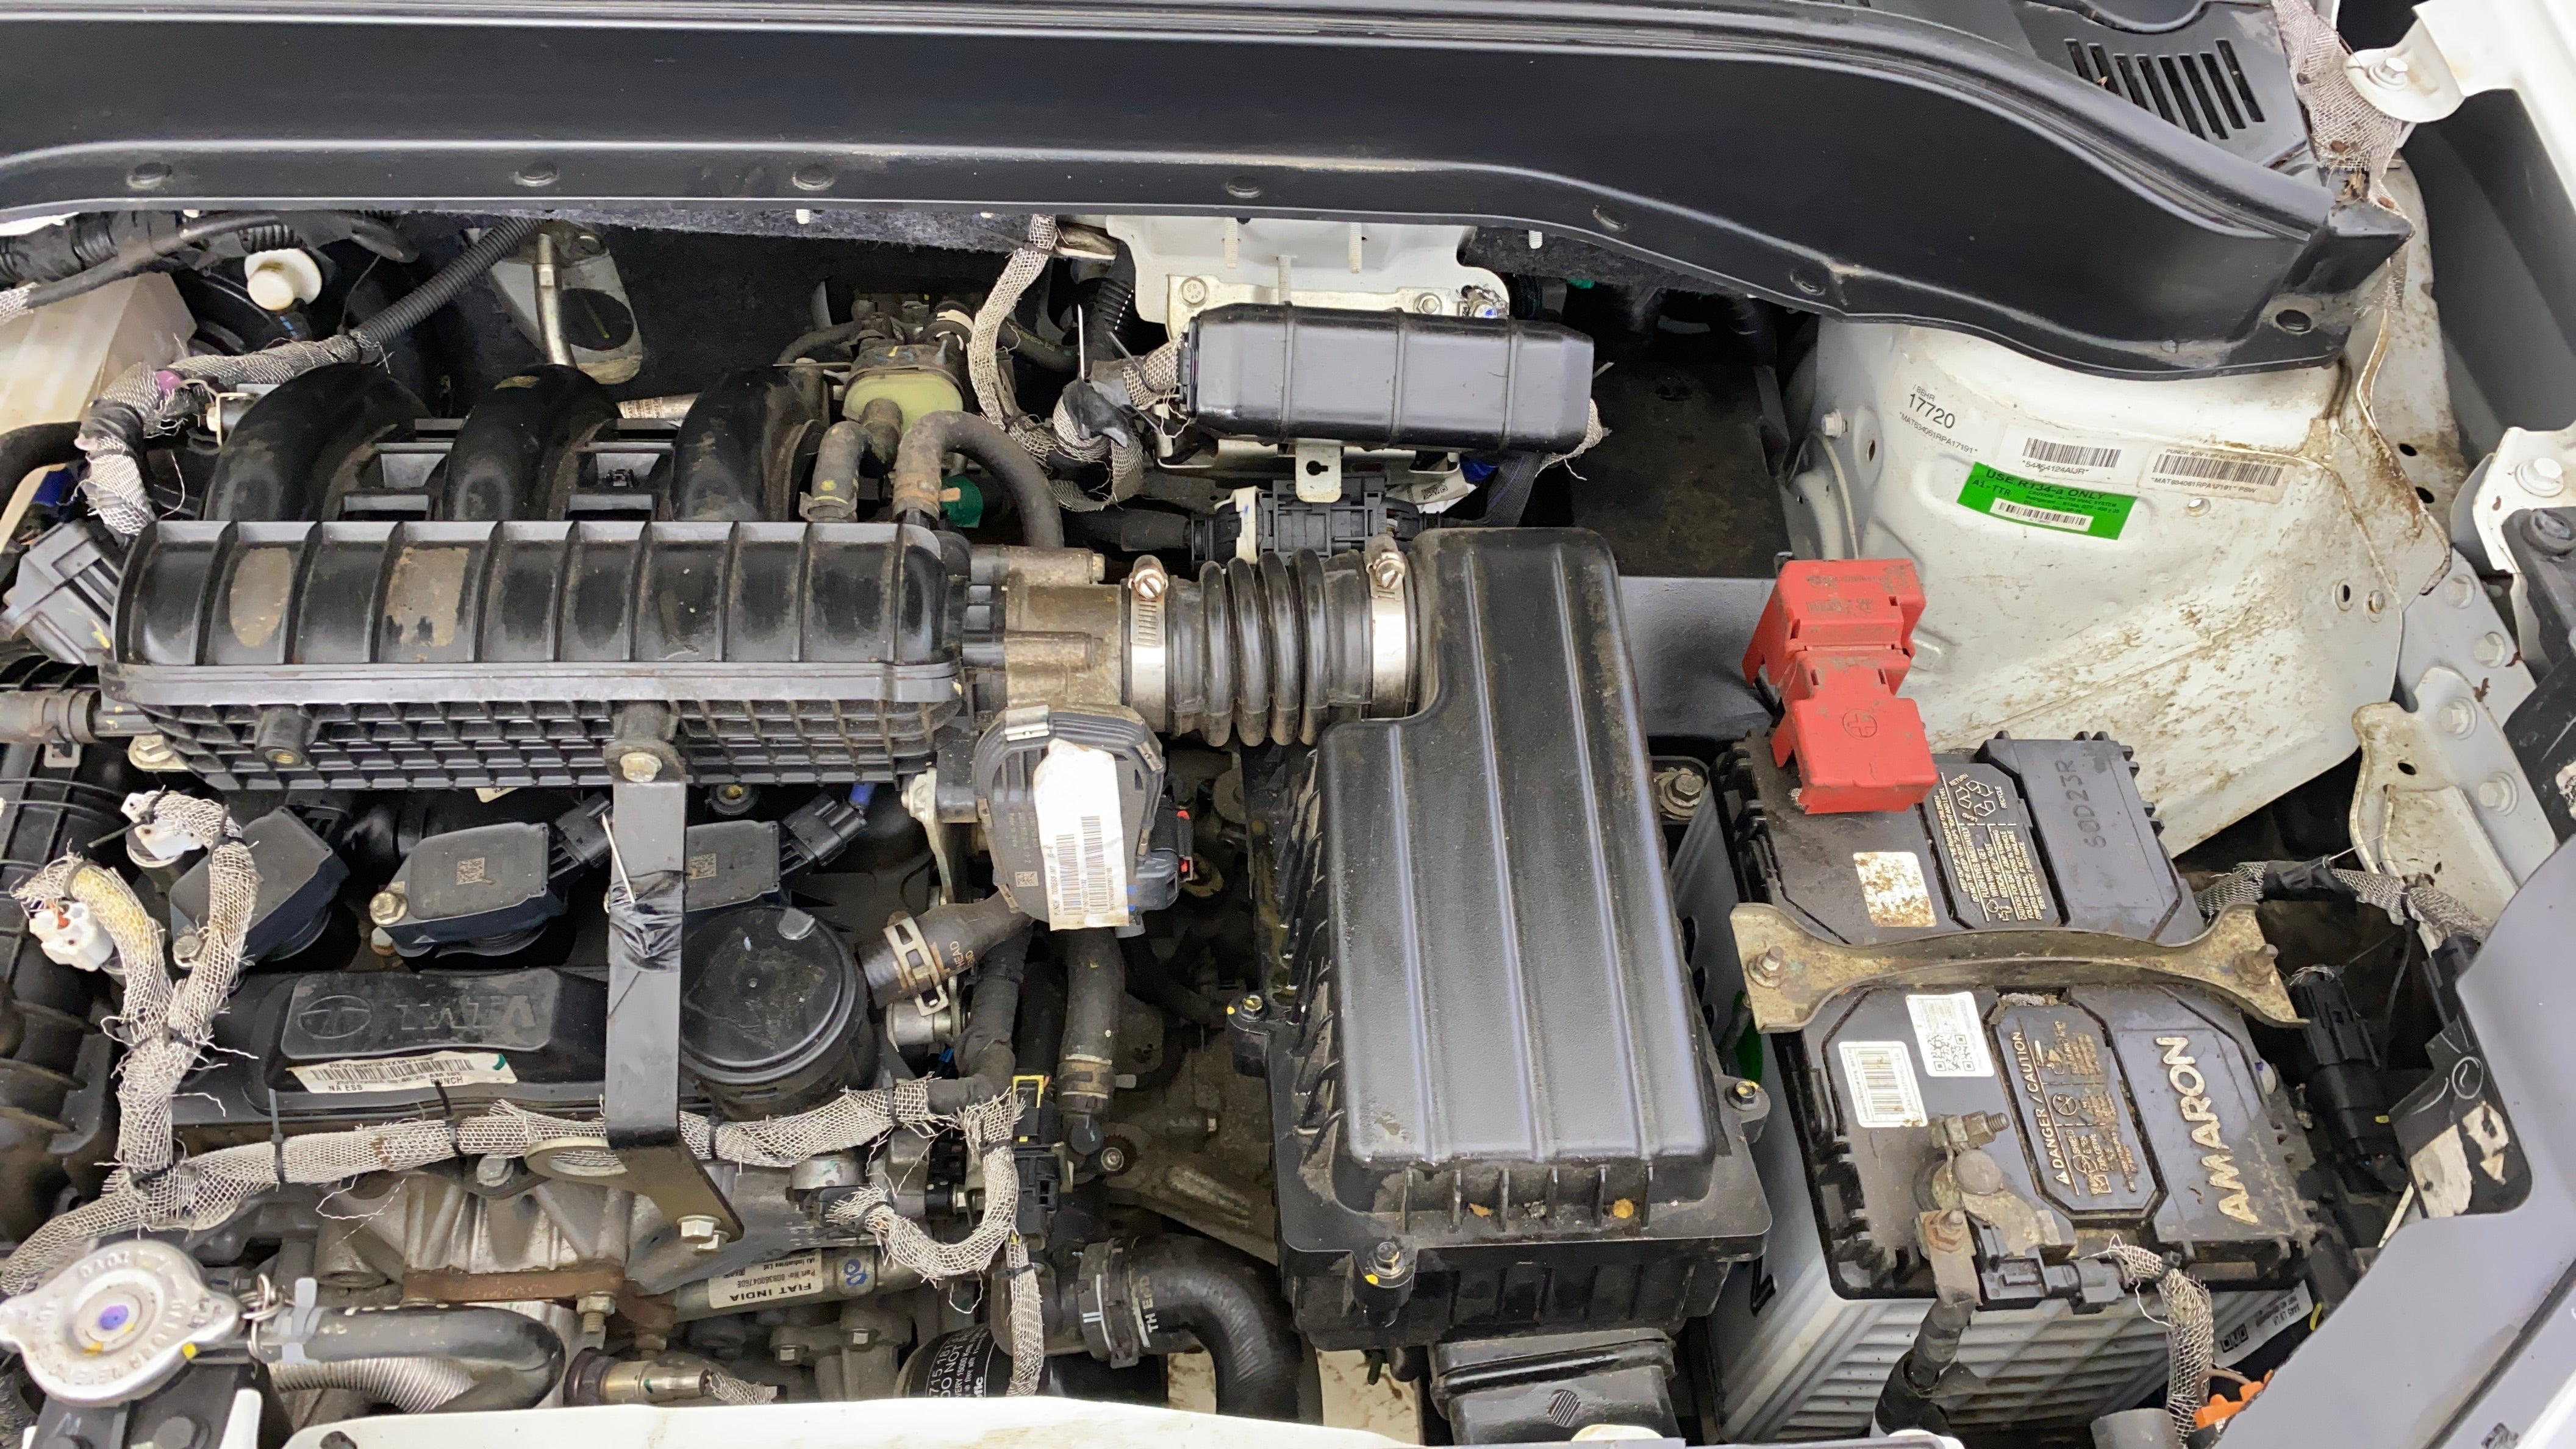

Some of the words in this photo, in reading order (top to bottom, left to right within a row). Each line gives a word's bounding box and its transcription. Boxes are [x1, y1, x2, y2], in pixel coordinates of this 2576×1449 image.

[1916, 385, 1936, 402] BEHR
[1909, 393, 1956, 429] 17720
[1986, 469, 2014, 484] USE
[2017, 479, 2063, 495] R134-a
[2067, 489, 2107, 500] ONLY
[1937, 788, 1948, 801] LEVEL
[1994, 785, 2007, 810] RECYCLE
[1999, 831, 2013, 850] VEHICLE
[1977, 849, 1987, 859] GET
[2015, 857, 2025, 866] NOT
[1972, 864, 1984, 878] EYES
[1958, 879, 1970, 891] KEEP
[1967, 882, 1977, 893] NOT
[1977, 880, 1990, 897] FLUSH
[1987, 882, 1999, 896] WITH
[1994, 874, 2009, 897] MEDICAL
[2009, 885, 2019, 893] FOR
[2020, 898, 2034, 918] FOLLOW
[2034, 896, 2047, 909] SEEK
[950, 941, 965, 968] HEAD
[2009, 1032, 2040, 1092] CAUTION
[2033, 1109, 2065, 1168] DANGER
[2155, 1036, 2259, 1226] AMARON
[729, 1289, 772, 1302] INDIA
[778, 1283, 812, 1294] FIAT
[1147, 1312, 1161, 1334] TH
[943, 1345, 963, 1373] NOT
[940, 1377, 952, 1398] DO
